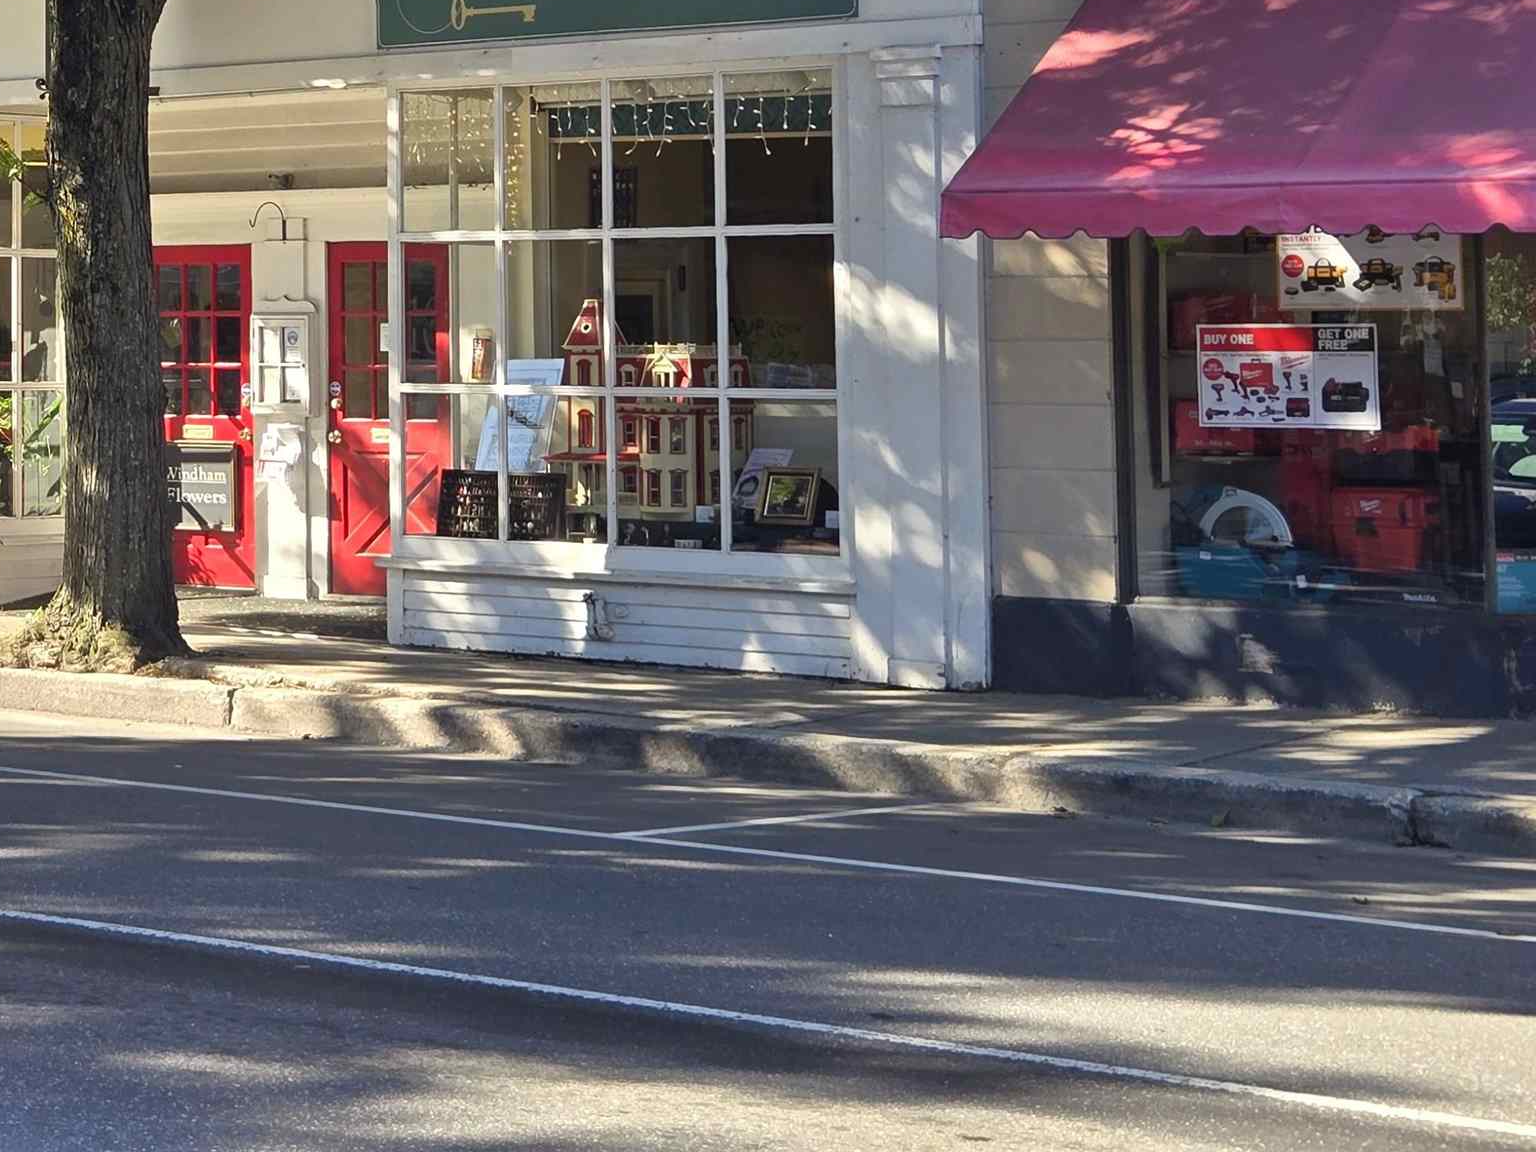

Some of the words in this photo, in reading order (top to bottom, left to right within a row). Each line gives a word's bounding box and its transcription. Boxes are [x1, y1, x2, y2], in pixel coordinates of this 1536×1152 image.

[1203, 334, 1227, 345] BUY
[1230, 333, 1254, 345] ONE
[1317, 328, 1341, 339] GET
[1344, 328, 1370, 339] ONE
[1318, 339, 1348, 350] FREE
